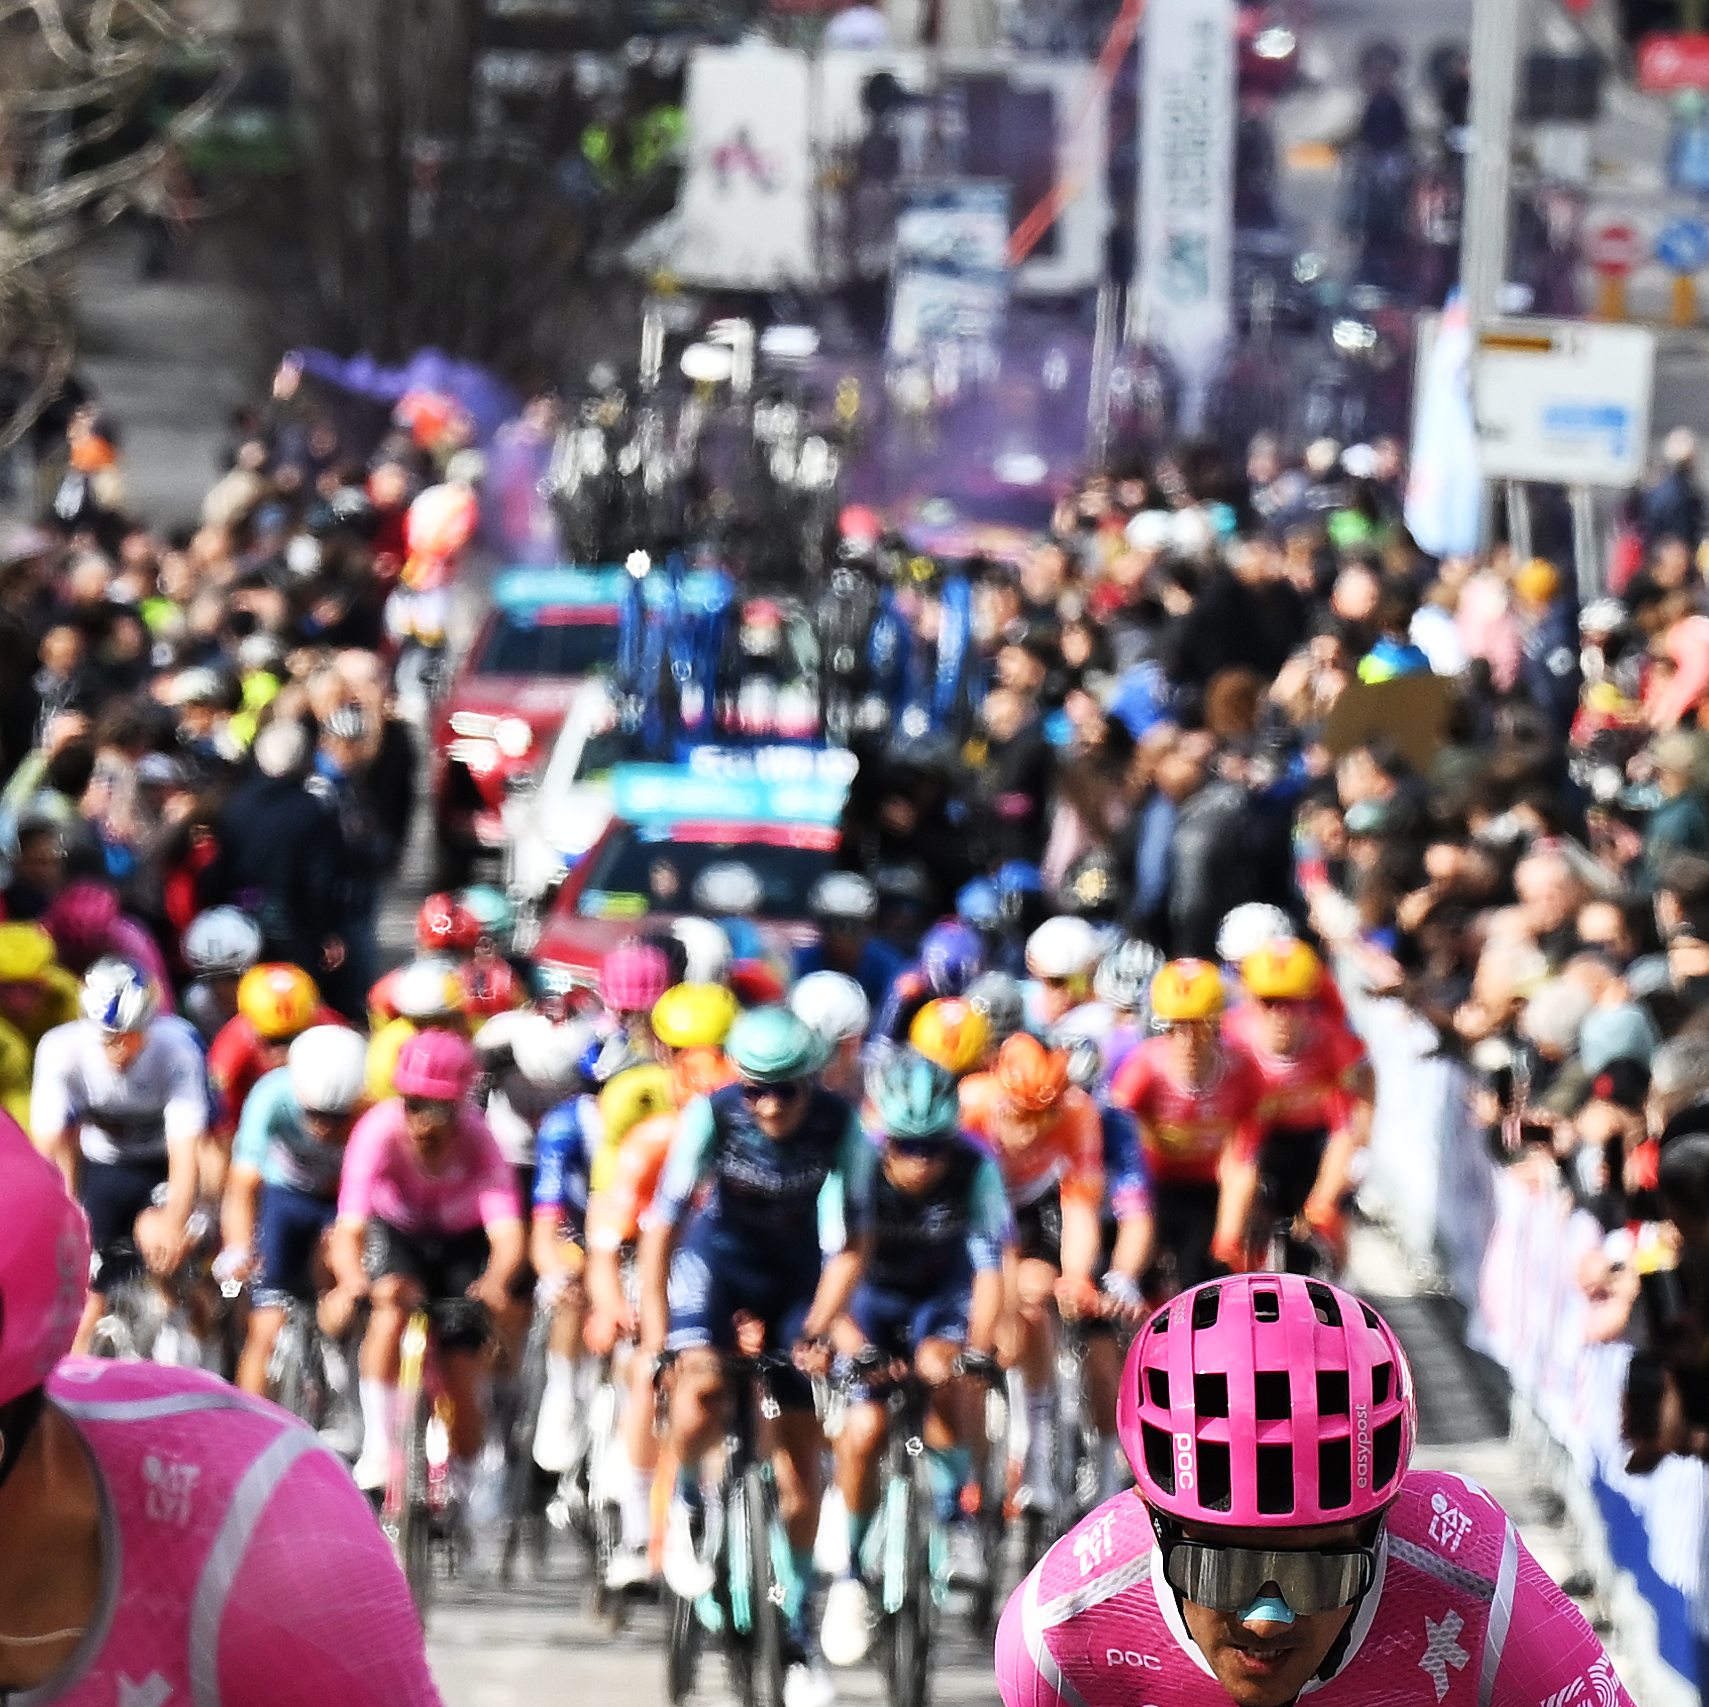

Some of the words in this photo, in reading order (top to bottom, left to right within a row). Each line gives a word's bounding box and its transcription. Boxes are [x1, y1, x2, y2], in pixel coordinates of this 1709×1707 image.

[1174, 1432, 1194, 1490] poc
[1356, 1403, 1372, 1489] easypost
[1106, 1648, 1163, 1671] poc
